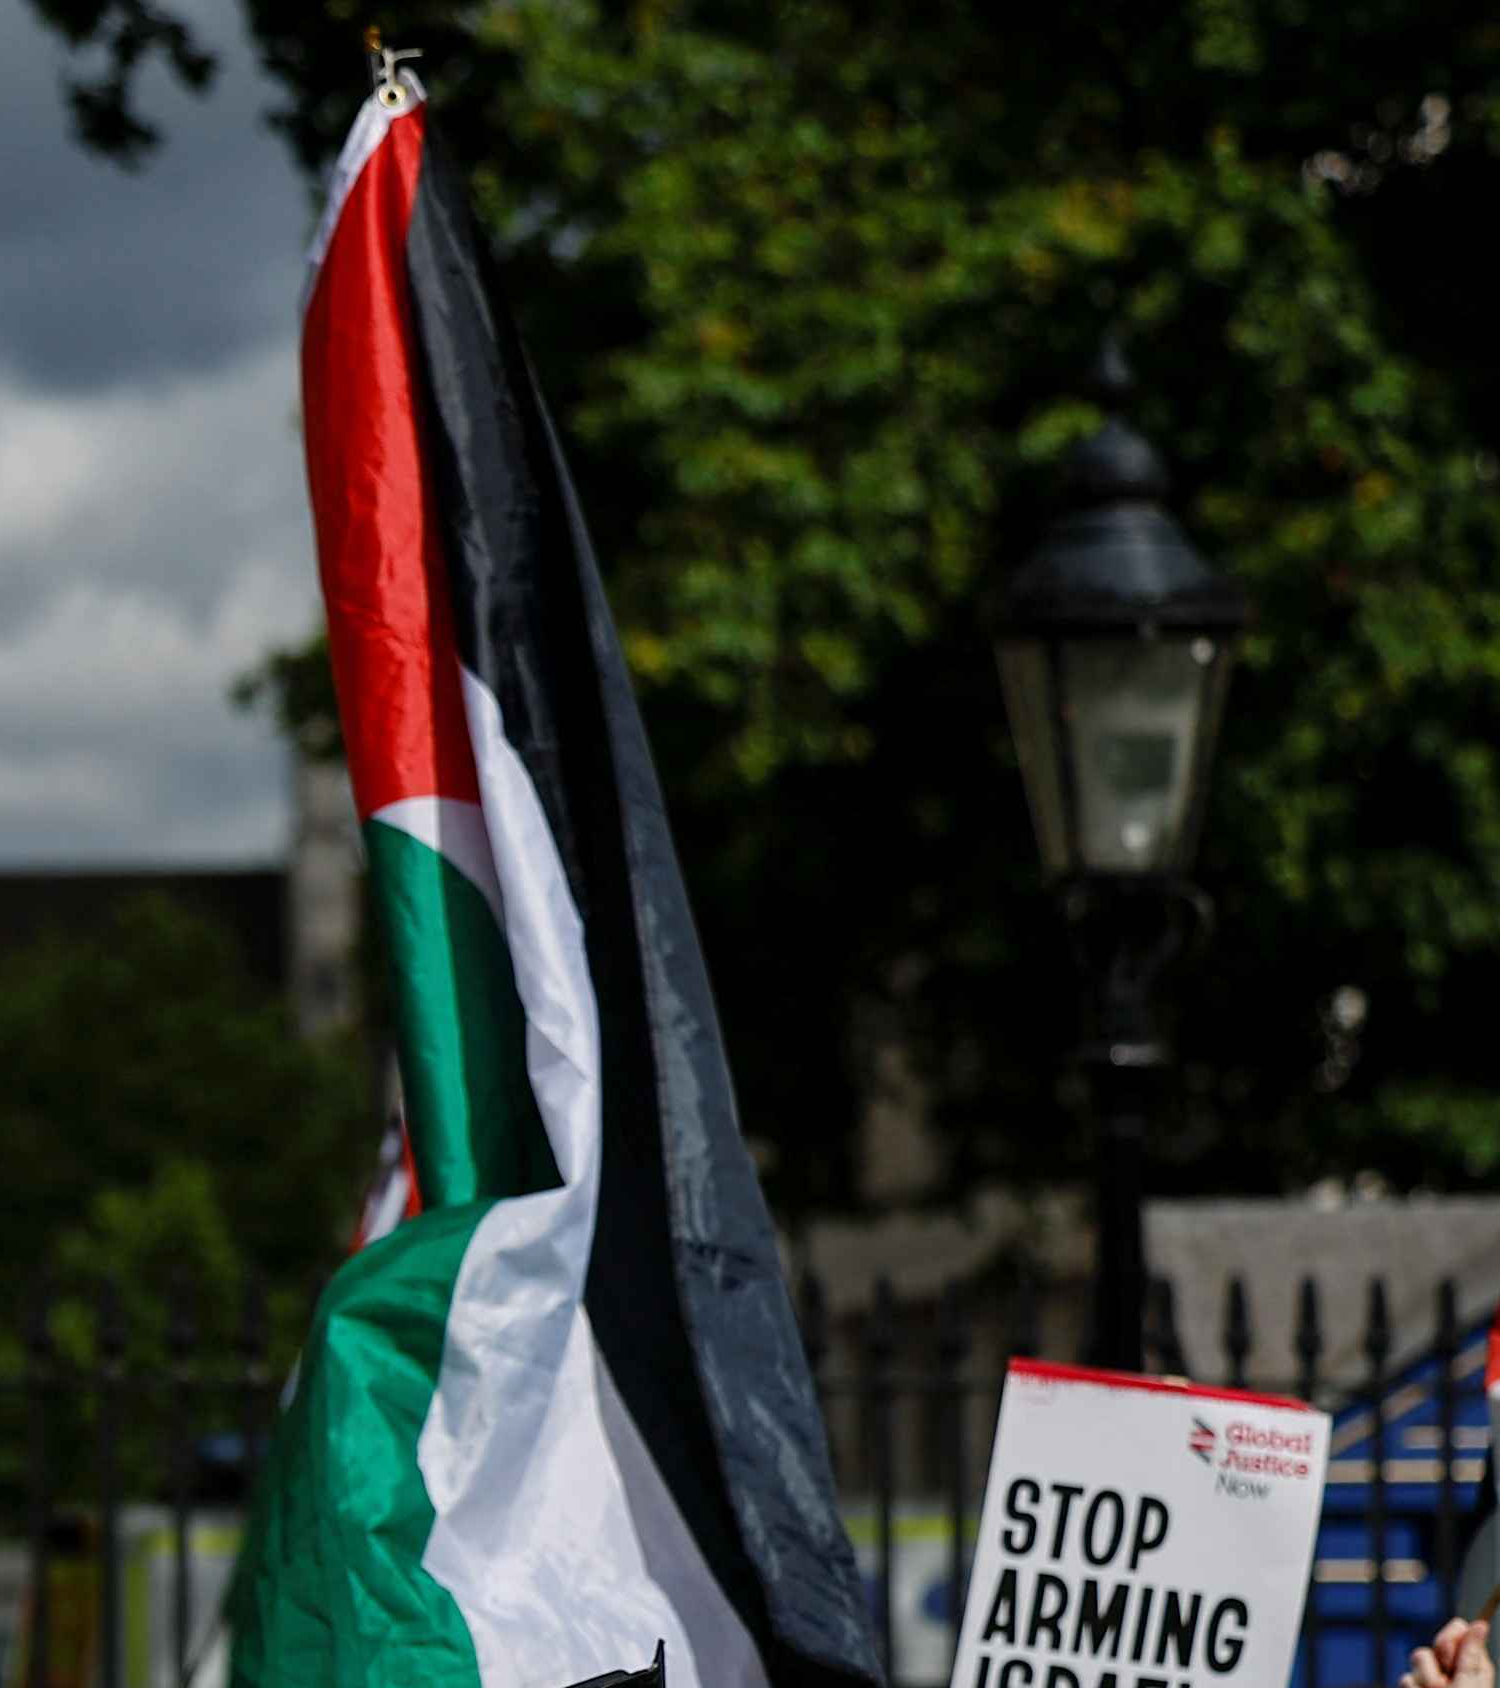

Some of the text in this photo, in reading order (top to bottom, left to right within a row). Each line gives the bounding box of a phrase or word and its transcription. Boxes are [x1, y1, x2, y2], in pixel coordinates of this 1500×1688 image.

[1225, 1422, 1311, 1453] Global
[1219, 1451, 1309, 1475] Justice
[1215, 1473, 1271, 1498] Now
[1002, 1478, 1169, 1570] STOP
[982, 1568, 1249, 1673] ARMING
